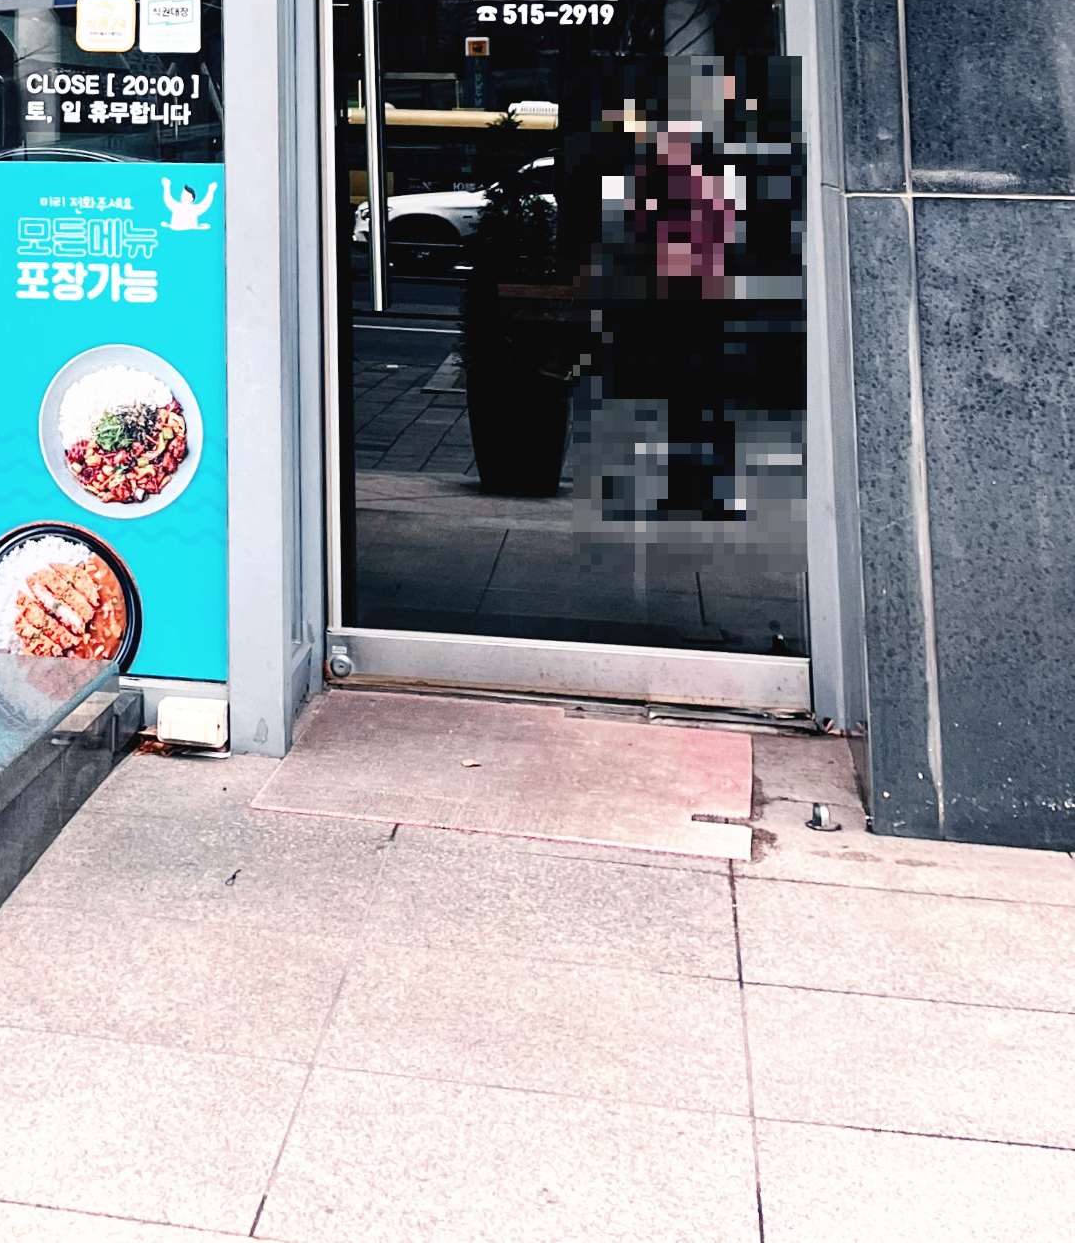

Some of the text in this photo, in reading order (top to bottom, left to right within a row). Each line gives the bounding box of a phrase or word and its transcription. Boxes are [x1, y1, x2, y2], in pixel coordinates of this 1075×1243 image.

[152, 6, 189, 18] 식권대장
[503, 3, 614, 26] 515-2919
[26, 74, 100, 95] CLOSE
[122, 75, 184, 96] 20:00
[25, 101, 191, 125] 토, 일 휴무합니다
[39, 196, 66, 209] 미리
[16, 217, 159, 259] 모든메뉴
[15, 261, 159, 302] 포장가능
